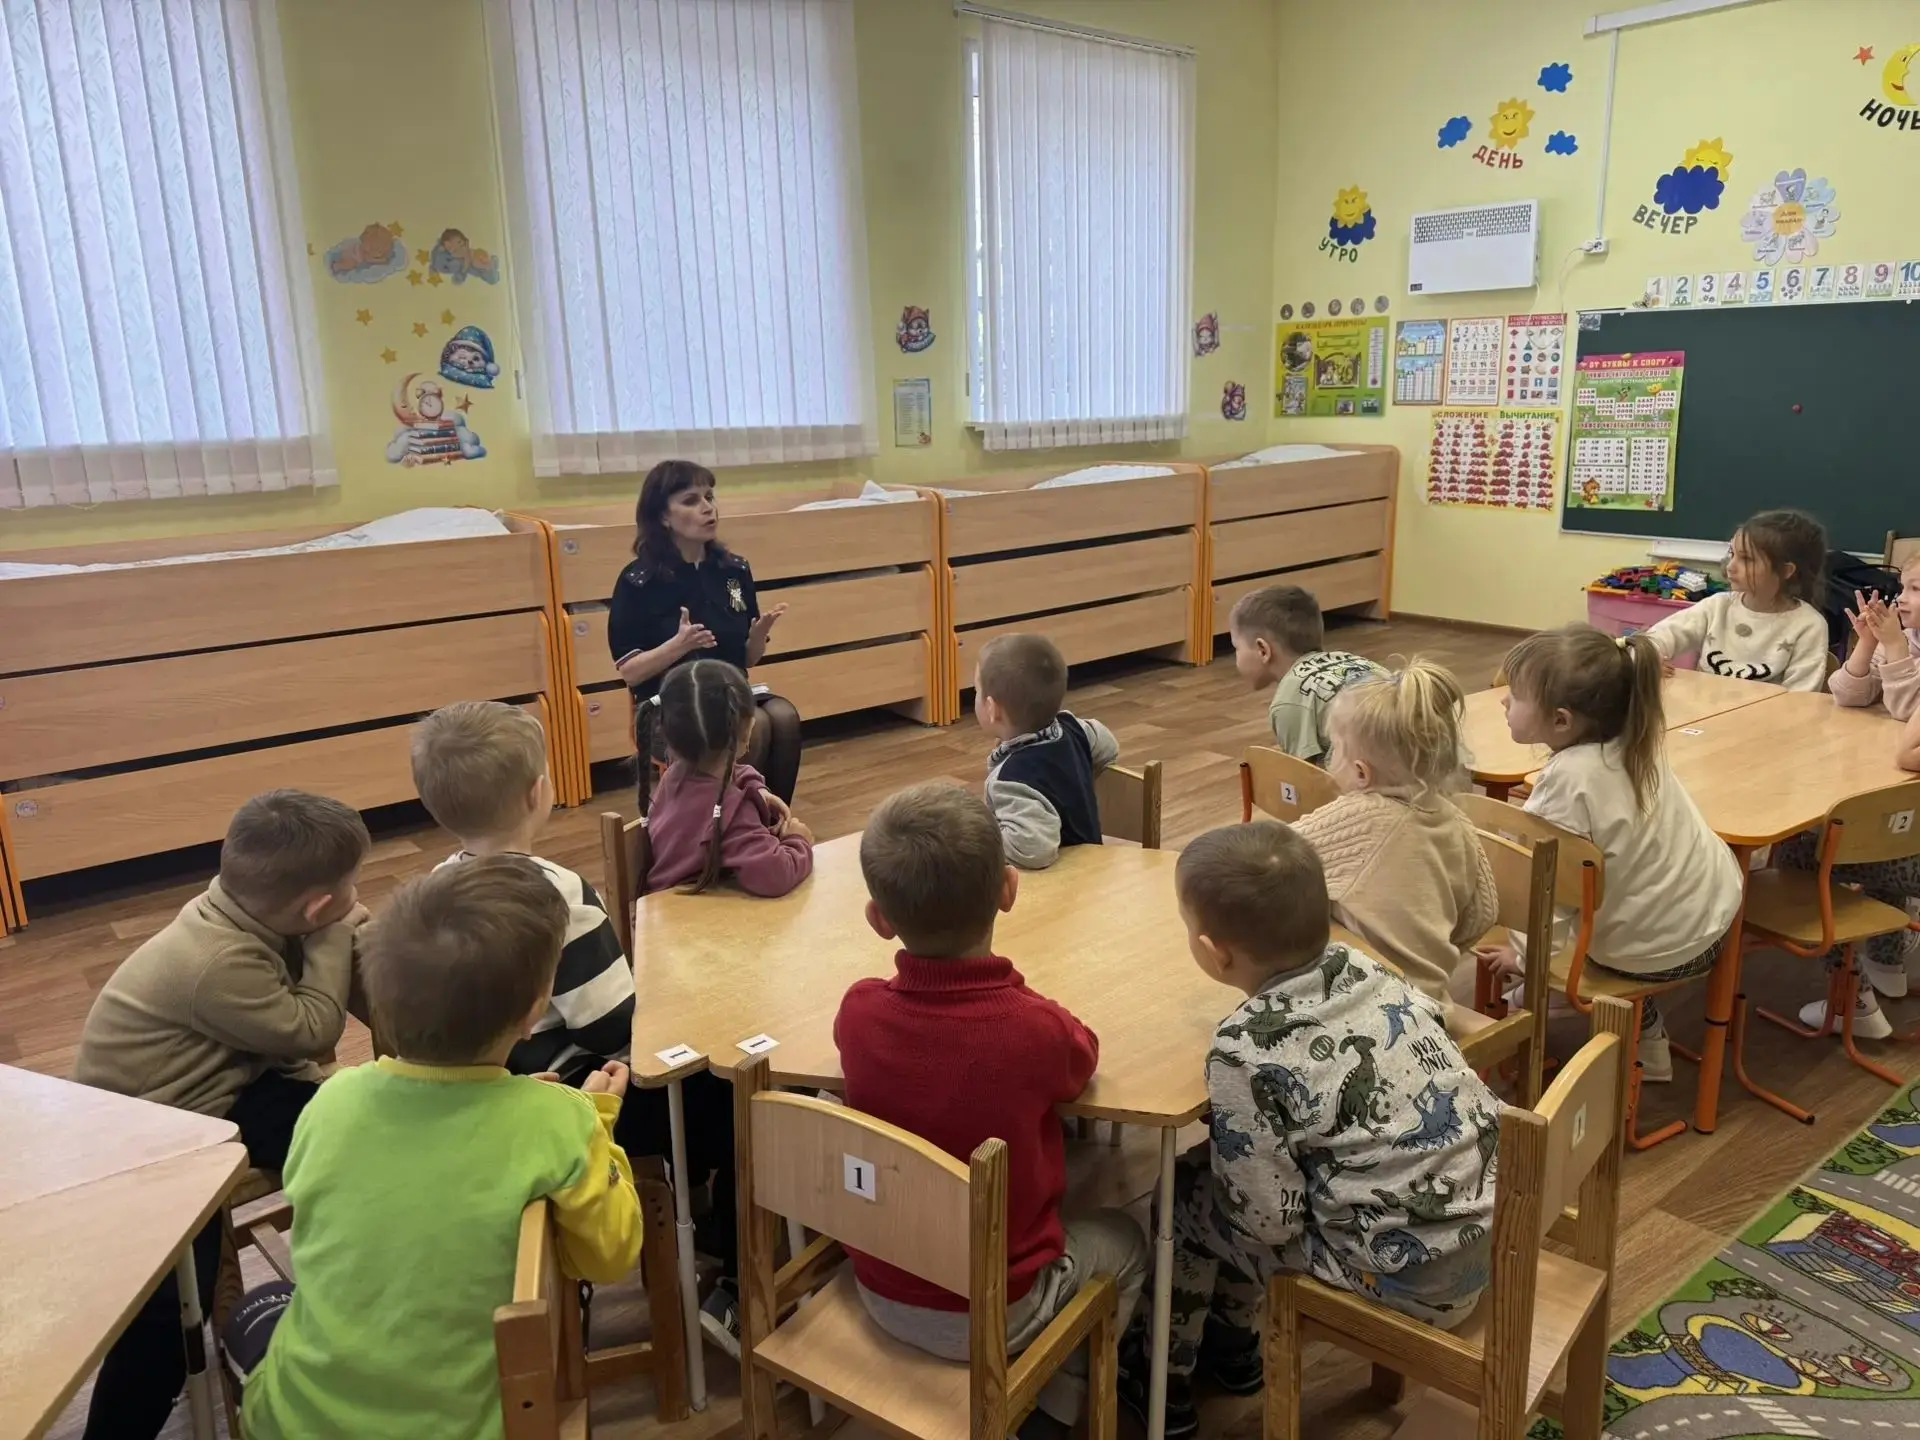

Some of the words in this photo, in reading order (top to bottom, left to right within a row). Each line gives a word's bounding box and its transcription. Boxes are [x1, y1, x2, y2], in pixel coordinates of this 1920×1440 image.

[1472, 145, 1523, 169] ДЕНЬ
[1632, 204, 1698, 235] ВЕЧЕР
[1318, 236, 1358, 263] УТРО
[1652, 278, 1661, 295] 1
[1676, 276, 1688, 294] 2
[1702, 275, 1714, 293] 3
[1728, 273, 1741, 291] 4
[1756, 272, 1769, 290] 5
[1787, 269, 1800, 288] 6
[1816, 268, 1829, 286] 7
[1844, 266, 1858, 284] 8
[1874, 264, 1889, 283] 9
[1900, 262, 1920, 281] 10
[1438, 411, 1488, 419] СЛОЖЕНИЕ
[1500, 410, 1555, 419] ВЫЧИТАНИЕ
[1285, 787, 1292, 800] 2
[669, 1050, 687, 1059] 1
[750, 1039, 767, 1048] 1
[1407, 1036, 1442, 1058] TEAM
[853, 1167, 864, 1191] 1
